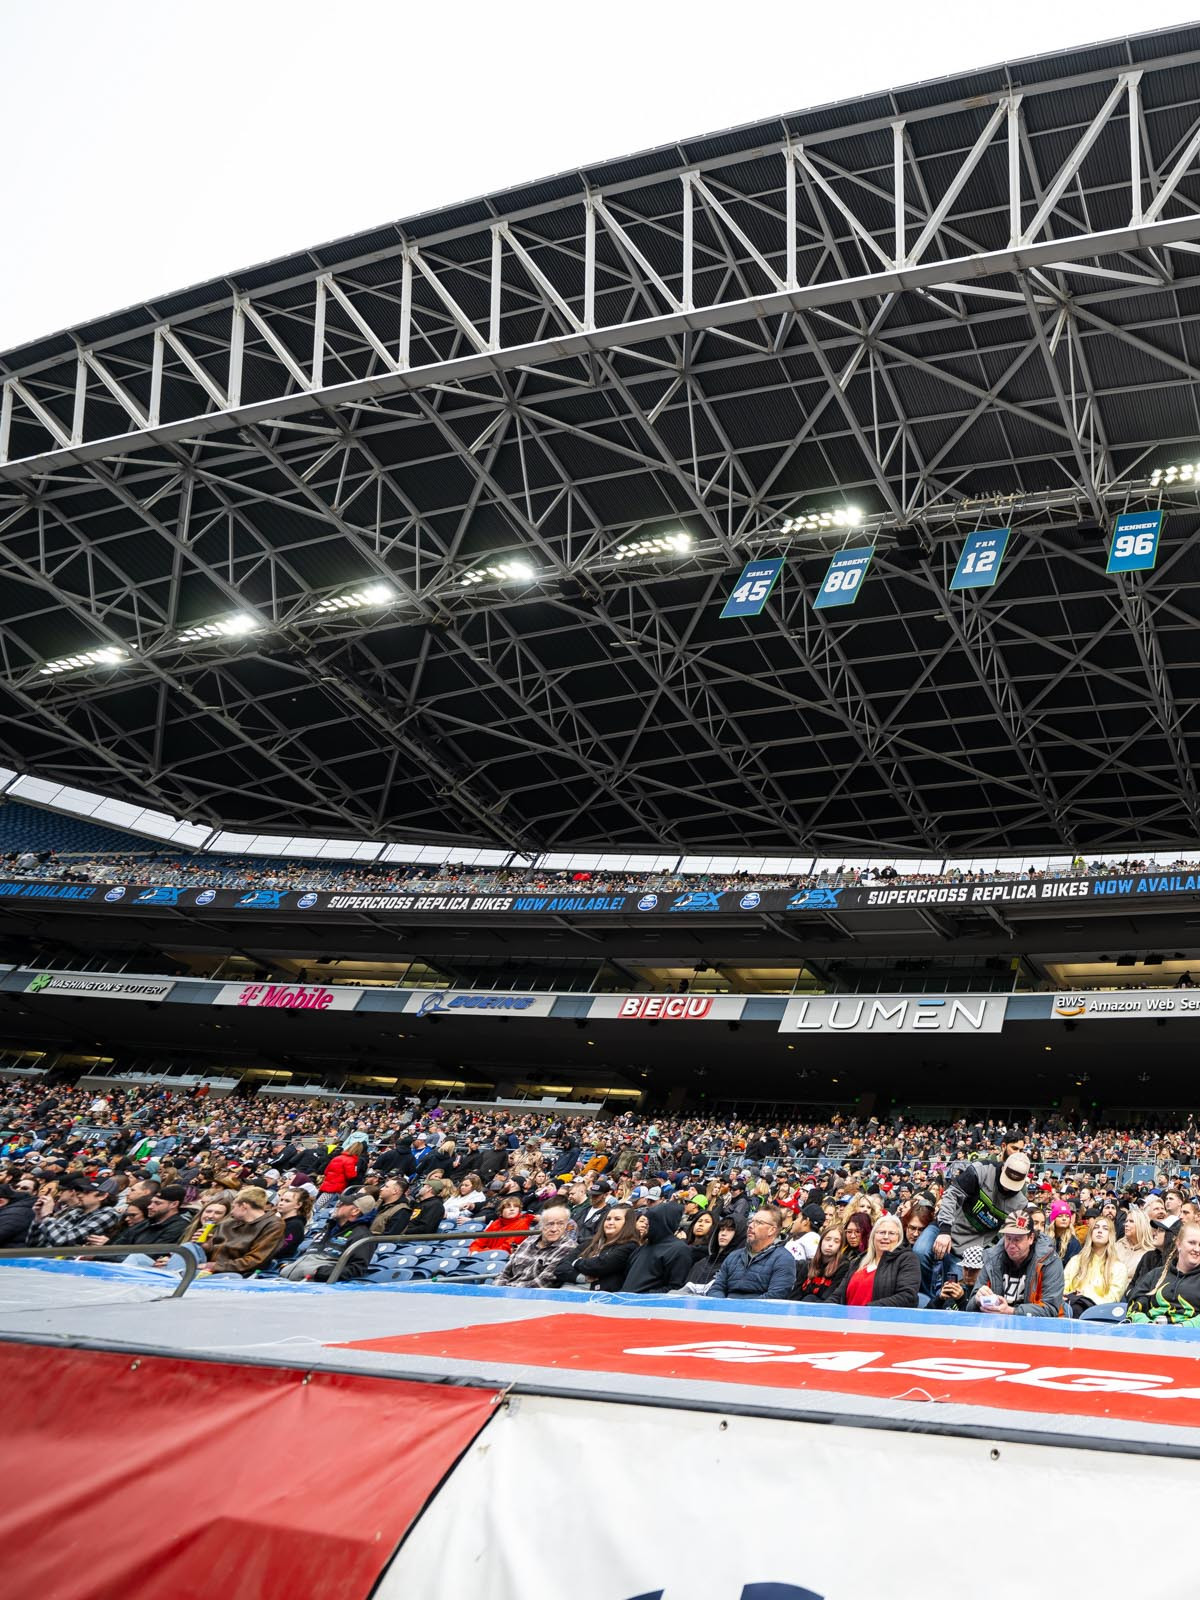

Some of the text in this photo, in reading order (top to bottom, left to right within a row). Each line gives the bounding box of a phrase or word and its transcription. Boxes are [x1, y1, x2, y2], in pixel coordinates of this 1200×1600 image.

[1118, 521, 1158, 532] KENNEDY
[975, 540, 996, 548] FAN
[1114, 533, 1154, 558] 96
[831, 557, 870, 568] LARGENT
[961, 550, 997, 574] 12
[823, 568, 862, 593] 80
[733, 579, 771, 603] 45
[20, 884, 97, 899] AVAILABLE!
[867, 889, 968, 905] SUPERCROSS
[972, 884, 1037, 901] REPLICA
[1041, 881, 1089, 898] BIKES
[1094, 880, 1130, 895] NOW
[327, 896, 414, 909] SUPERCROSS
[413, 897, 470, 910] REPLICA
[470, 897, 512, 910] BIKES
[512, 898, 549, 910] NOW
[547, 897, 626, 910] AVAILABLE!
[49, 978, 168, 995] WASHINGTON'S LOTTERY
[446, 995, 536, 1010] BOEING
[621, 997, 710, 1017] BECU
[1056, 995, 1085, 1007] aws
[1089, 1000, 1142, 1012] Amazon
[1146, 998, 1175, 1011] Web
[796, 1000, 988, 1030] LUMEN
